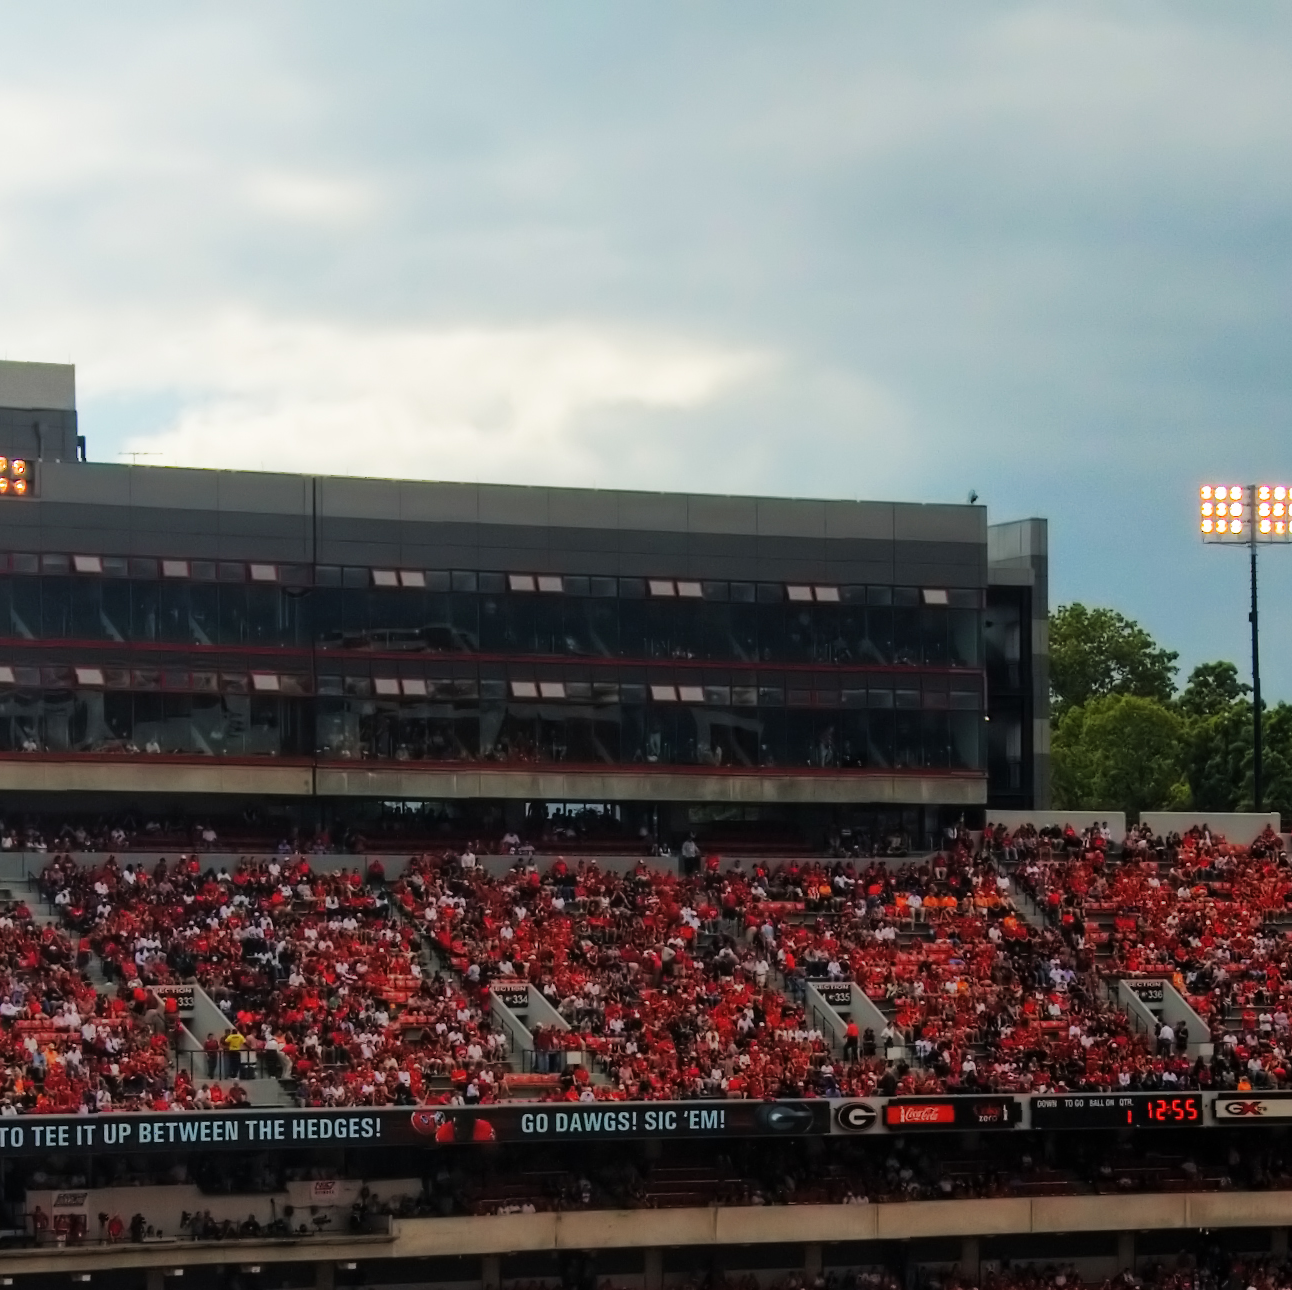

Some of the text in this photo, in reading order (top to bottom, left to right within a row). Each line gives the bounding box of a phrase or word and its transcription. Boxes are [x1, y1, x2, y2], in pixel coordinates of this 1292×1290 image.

[834, 992, 851, 1002] 335
[1148, 989, 1163, 999] 336
[178, 996, 194, 1006] 333
[512, 995, 528, 1004] 334
[1036, 1099, 1057, 1108] DOWN
[1064, 1099, 1073, 1108] TO
[1074, 1099, 1084, 1107] GO
[1089, 1098, 1104, 1107] BALL
[1105, 1098, 1114, 1107] ON
[1148, 1099, 1198, 1121] 12:55
[520, 1109, 726, 1134] GO DAWGS! SIC 'EM!
[30, 1124, 69, 1147] TEE
[76, 1124, 97, 1145] IT
[103, 1123, 132, 1145] UP
[138, 1120, 239, 1144] BETWEEN
[245, 1119, 286, 1141] THE
[291, 1117, 382, 1139] HEDGES!
